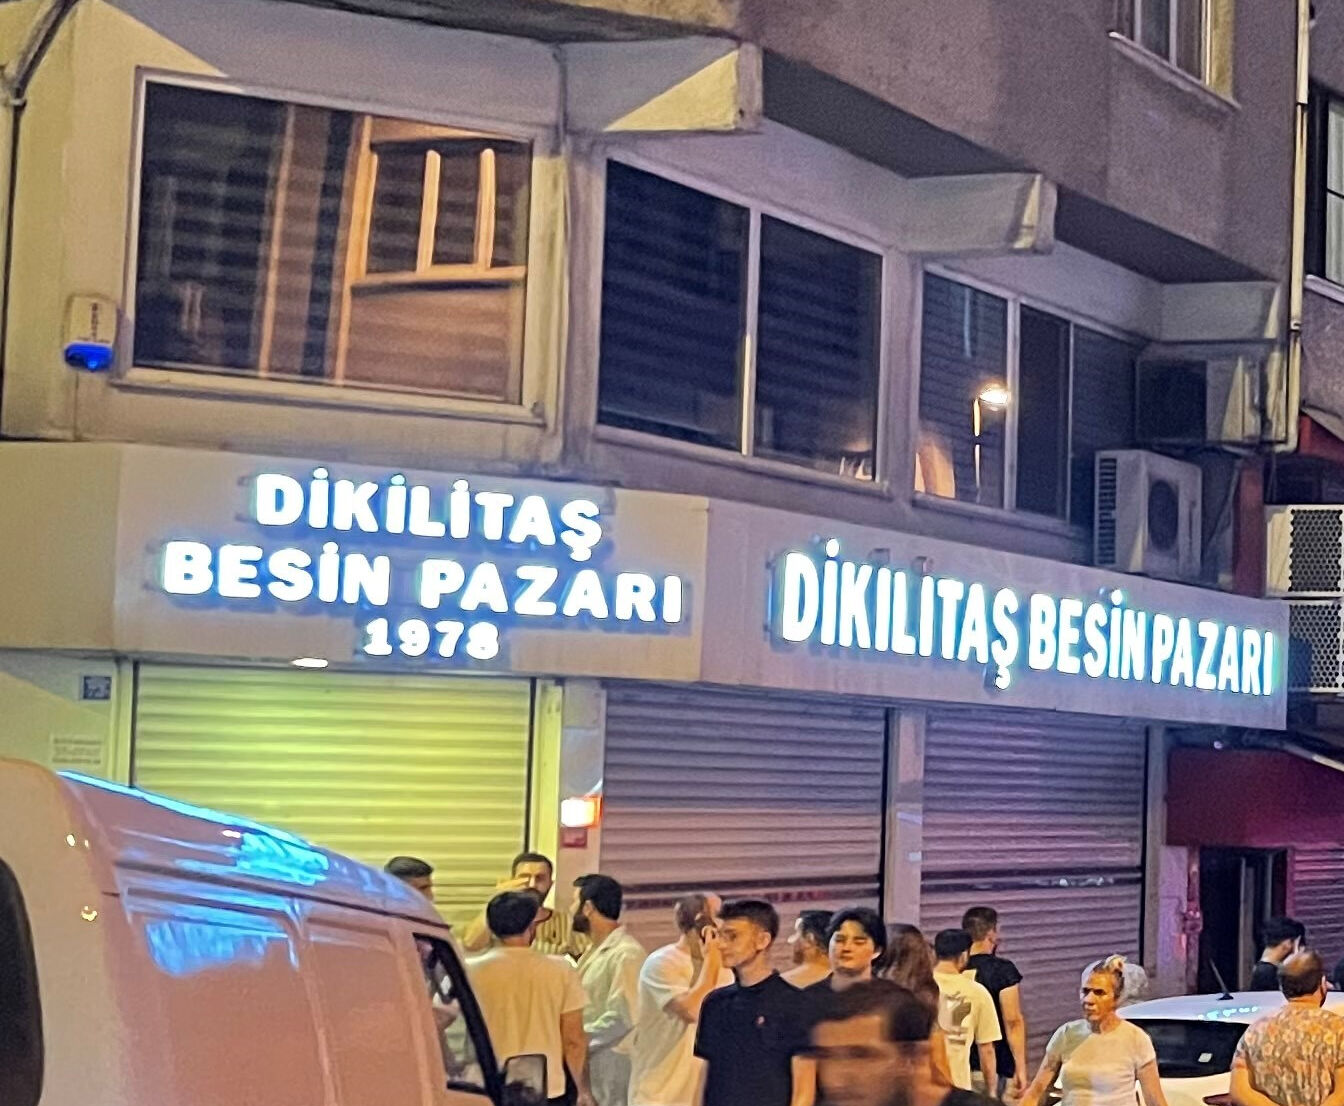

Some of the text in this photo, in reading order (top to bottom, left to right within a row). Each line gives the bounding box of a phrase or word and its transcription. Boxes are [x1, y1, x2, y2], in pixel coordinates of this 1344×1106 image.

[254, 467, 602, 561] DİKİLİTAŞ
[160, 541, 683, 623] BESİN PAZARI
[362, 618, 500, 660] 1978
[1027, 589, 1146, 681] BESİN
[1151, 611, 1275, 697] PAZARI
